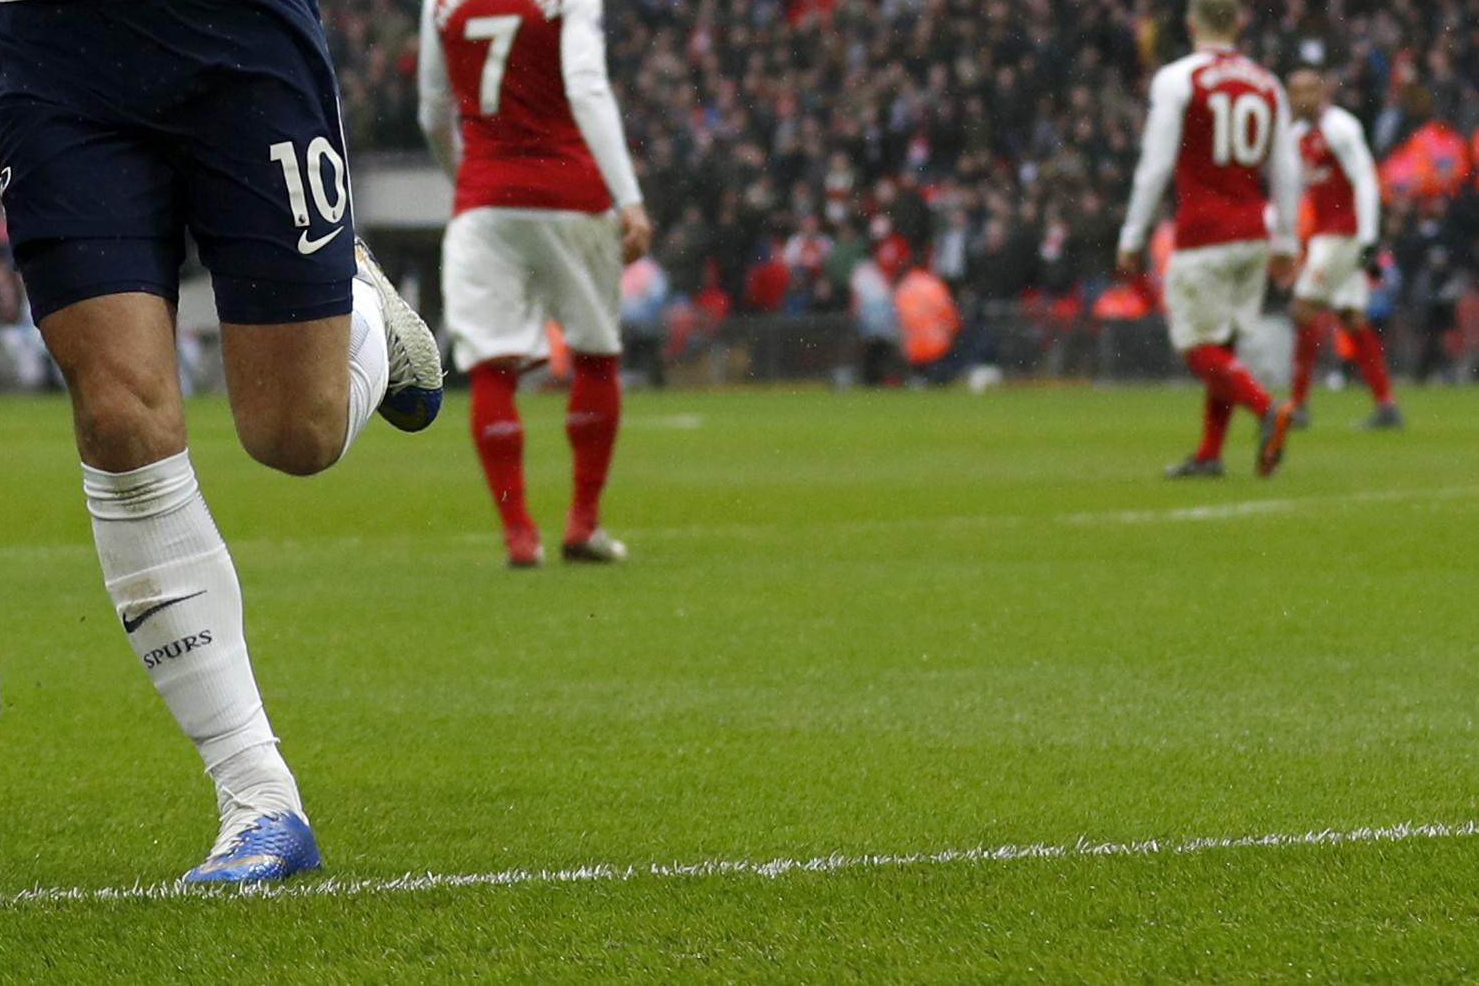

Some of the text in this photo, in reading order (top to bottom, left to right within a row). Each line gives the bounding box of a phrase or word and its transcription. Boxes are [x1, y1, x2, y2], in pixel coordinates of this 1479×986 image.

[464, 15, 521, 116] 7
[1207, 90, 1273, 166] 10
[270, 136, 346, 224] 10
[143, 629, 212, 669] SPURS
